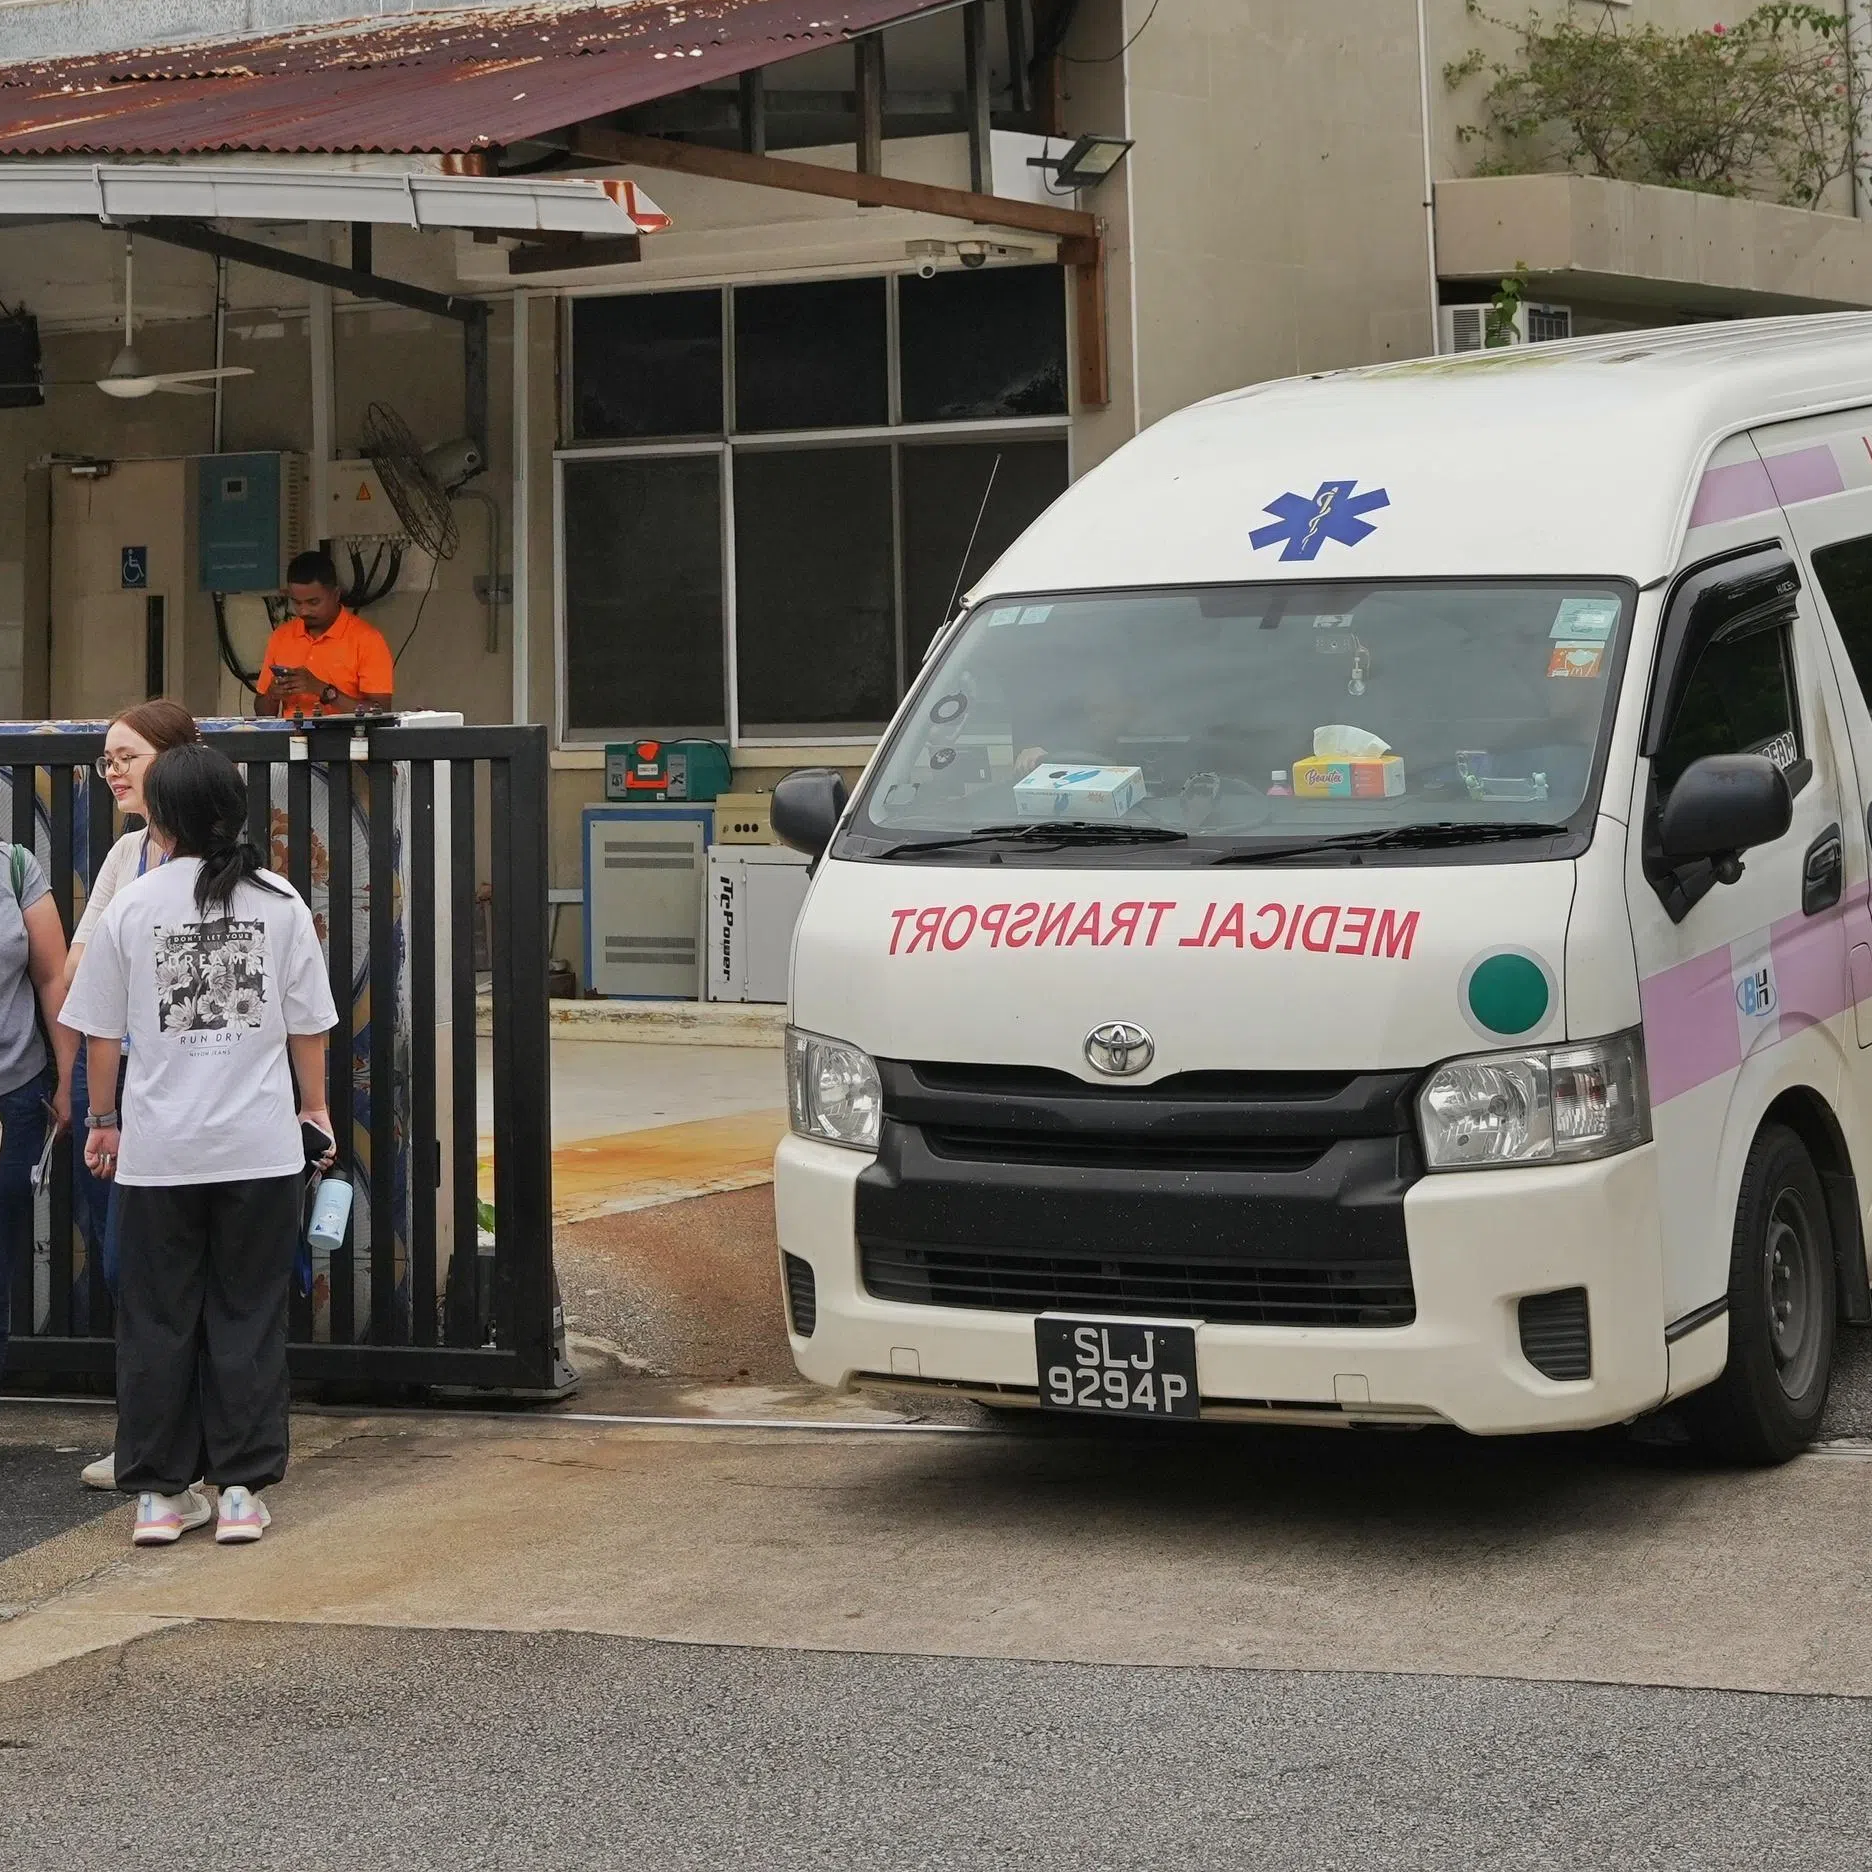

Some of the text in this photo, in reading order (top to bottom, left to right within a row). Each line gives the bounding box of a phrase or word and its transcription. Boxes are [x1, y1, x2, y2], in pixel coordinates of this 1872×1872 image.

[180, 1032, 243, 1045] RUN DRY
[1074, 1327, 1154, 1370] SLJ
[1048, 1366, 1188, 1413] 9294P
